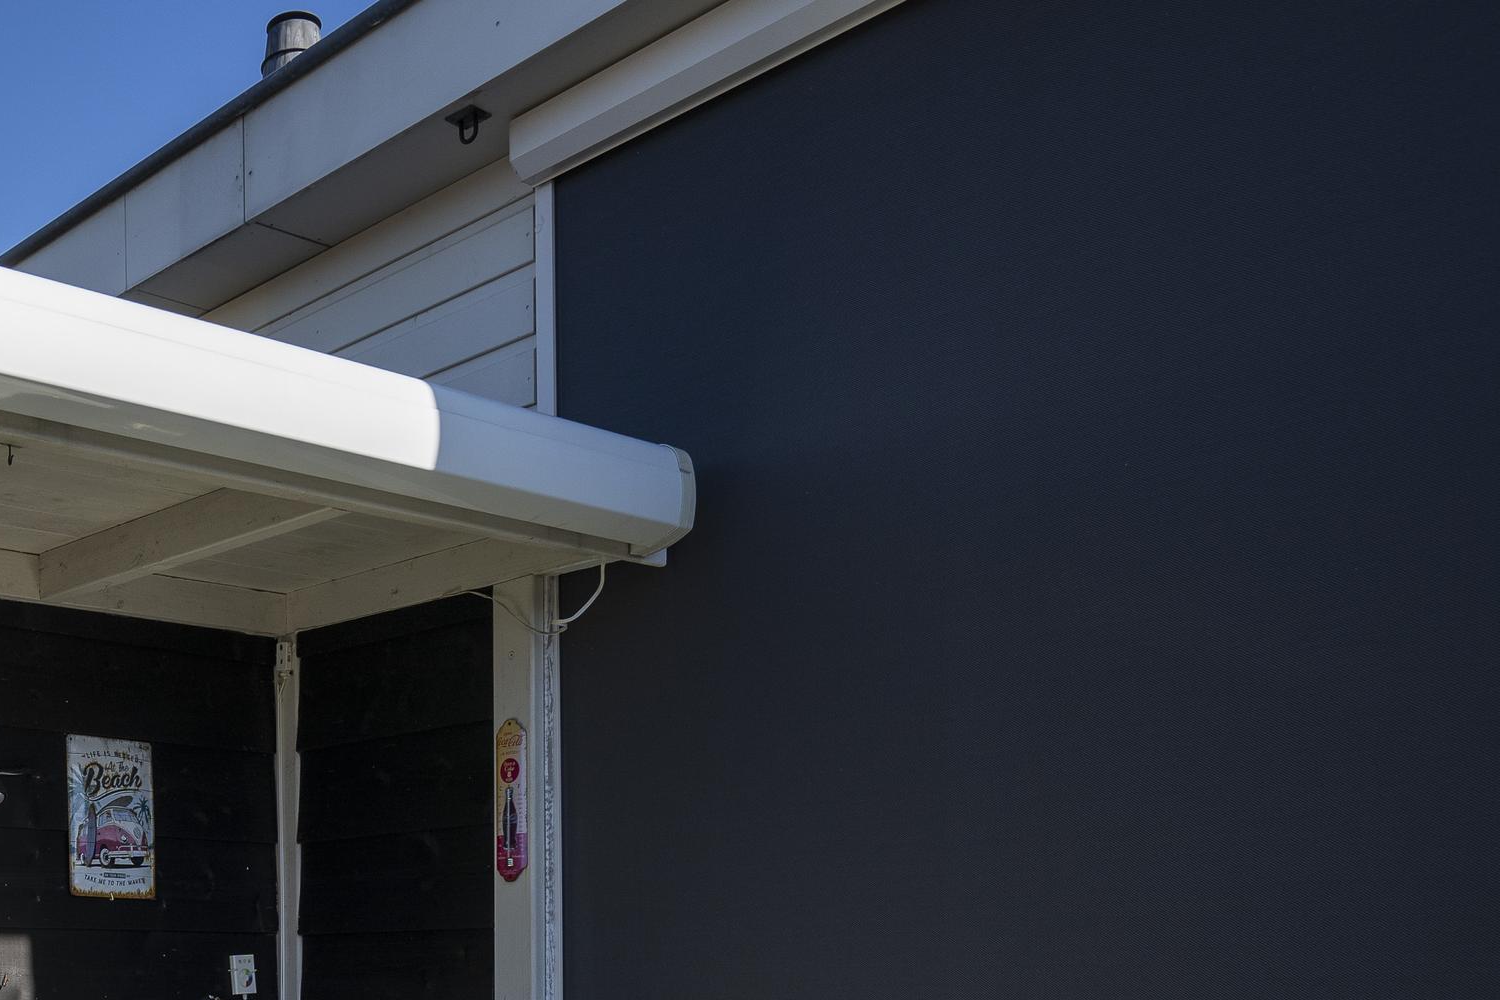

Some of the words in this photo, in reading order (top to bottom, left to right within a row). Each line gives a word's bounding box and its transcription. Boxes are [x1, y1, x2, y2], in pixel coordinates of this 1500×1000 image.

[85, 751, 101, 759] LIFE
[105, 761, 116, 772] At
[83, 762, 142, 796] Beach
[84, 874, 97, 882] TAKE
